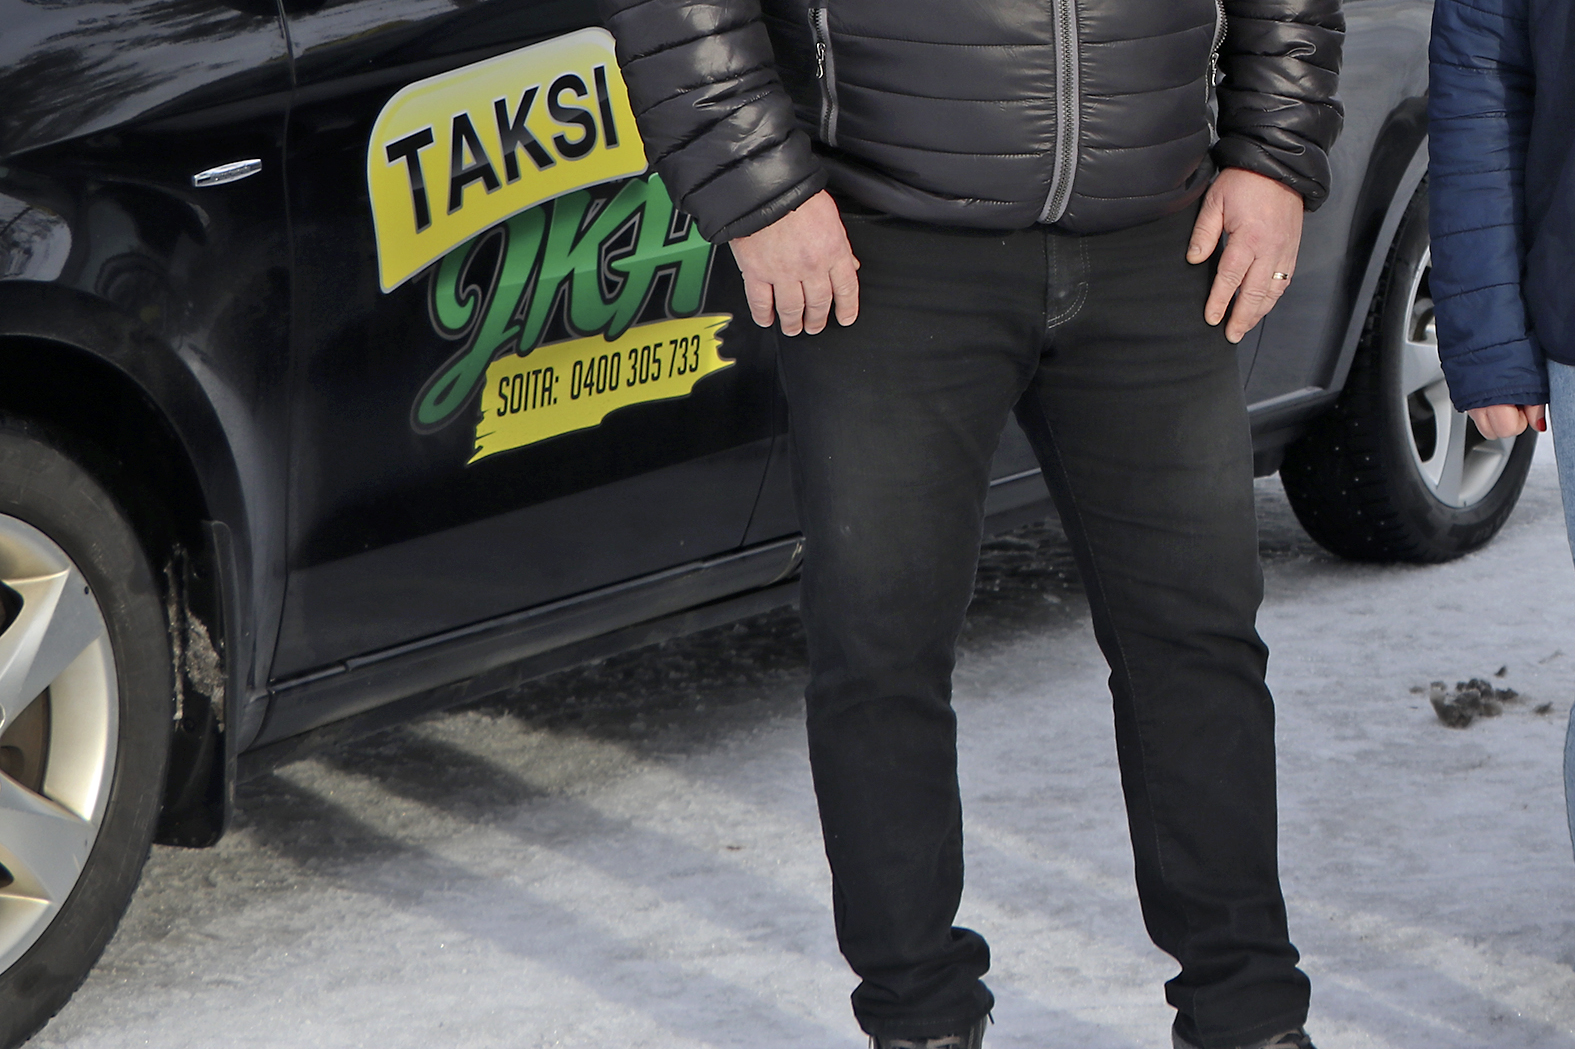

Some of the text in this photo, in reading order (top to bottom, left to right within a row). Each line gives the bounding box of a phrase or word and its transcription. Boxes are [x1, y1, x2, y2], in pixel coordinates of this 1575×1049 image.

[385, 65, 619, 235] TAKSI
[497, 334, 700, 417] SOITA: 0400 305 733
